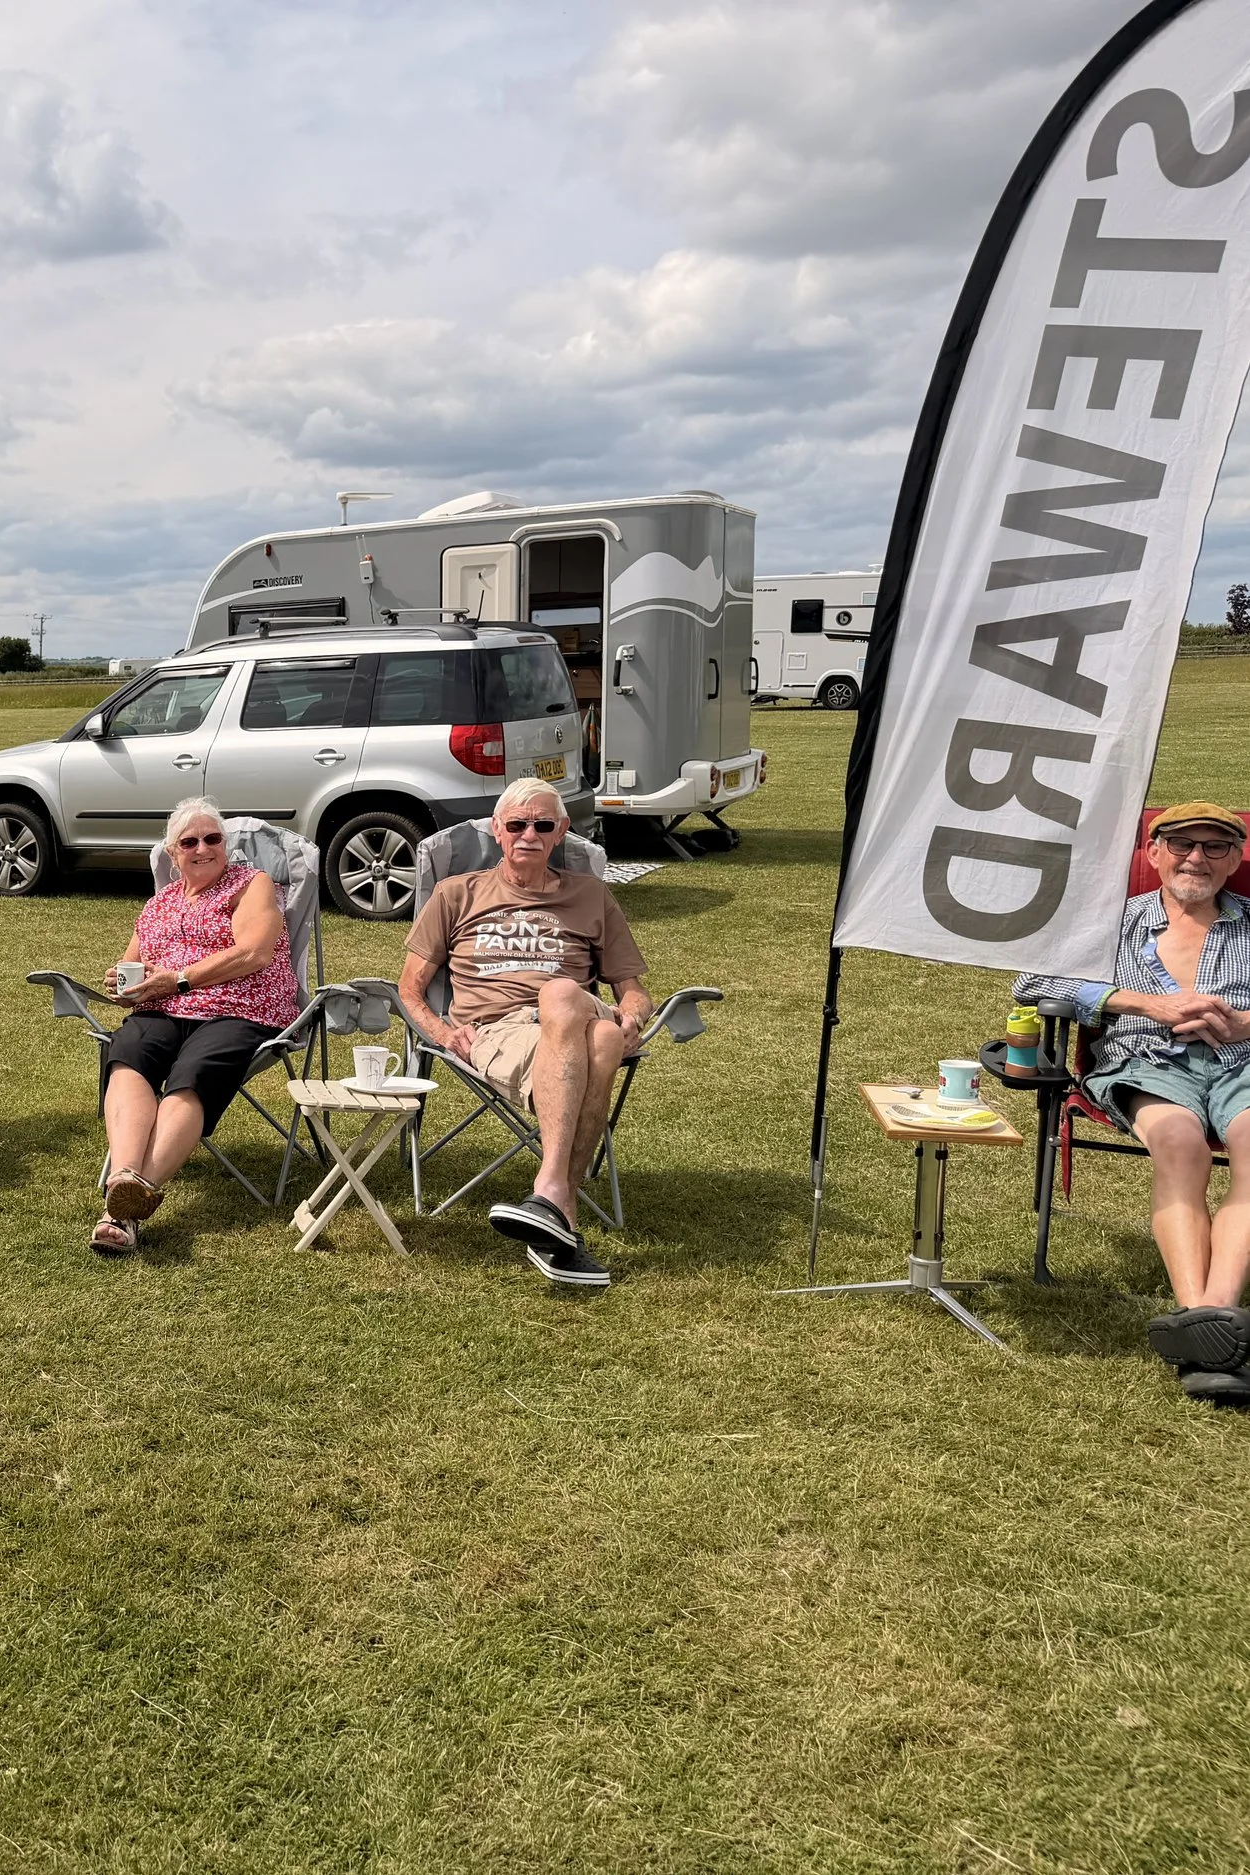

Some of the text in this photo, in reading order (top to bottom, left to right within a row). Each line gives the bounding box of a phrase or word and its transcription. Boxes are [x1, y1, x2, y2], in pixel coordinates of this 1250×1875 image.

[269, 575, 303, 587] DISCOVERY
[532, 913, 560, 925] GUARD
[477, 921, 560, 937] DON
[474, 934, 565, 954] PANIC!
[483, 963, 511, 971] DADS
